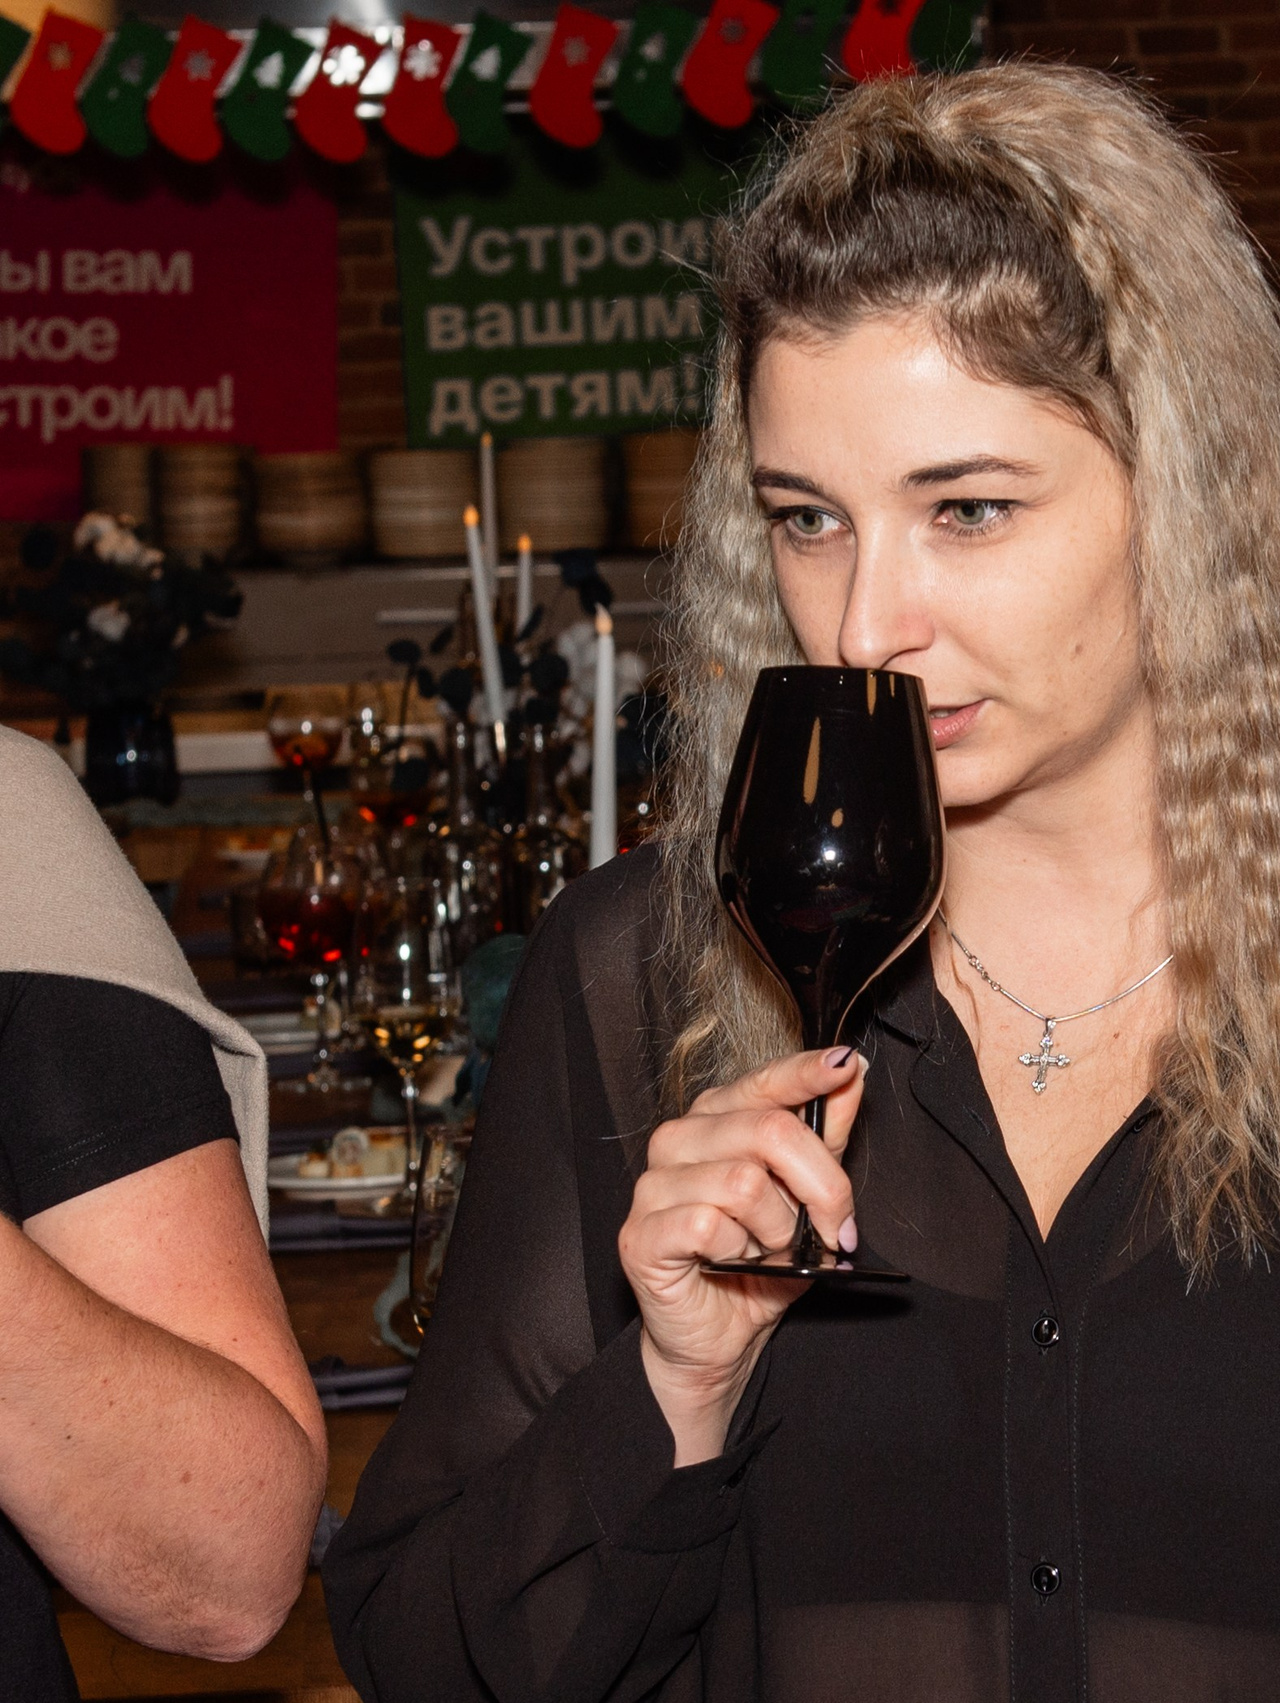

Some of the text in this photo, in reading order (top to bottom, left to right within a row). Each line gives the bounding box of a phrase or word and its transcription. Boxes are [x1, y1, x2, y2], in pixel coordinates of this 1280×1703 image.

[62, 250, 193, 294] вам
[419, 215, 716, 286] Устрои
[0, 316, 119, 362] кое
[426, 295, 701, 350] вашим
[428, 354, 700, 436] детям!
